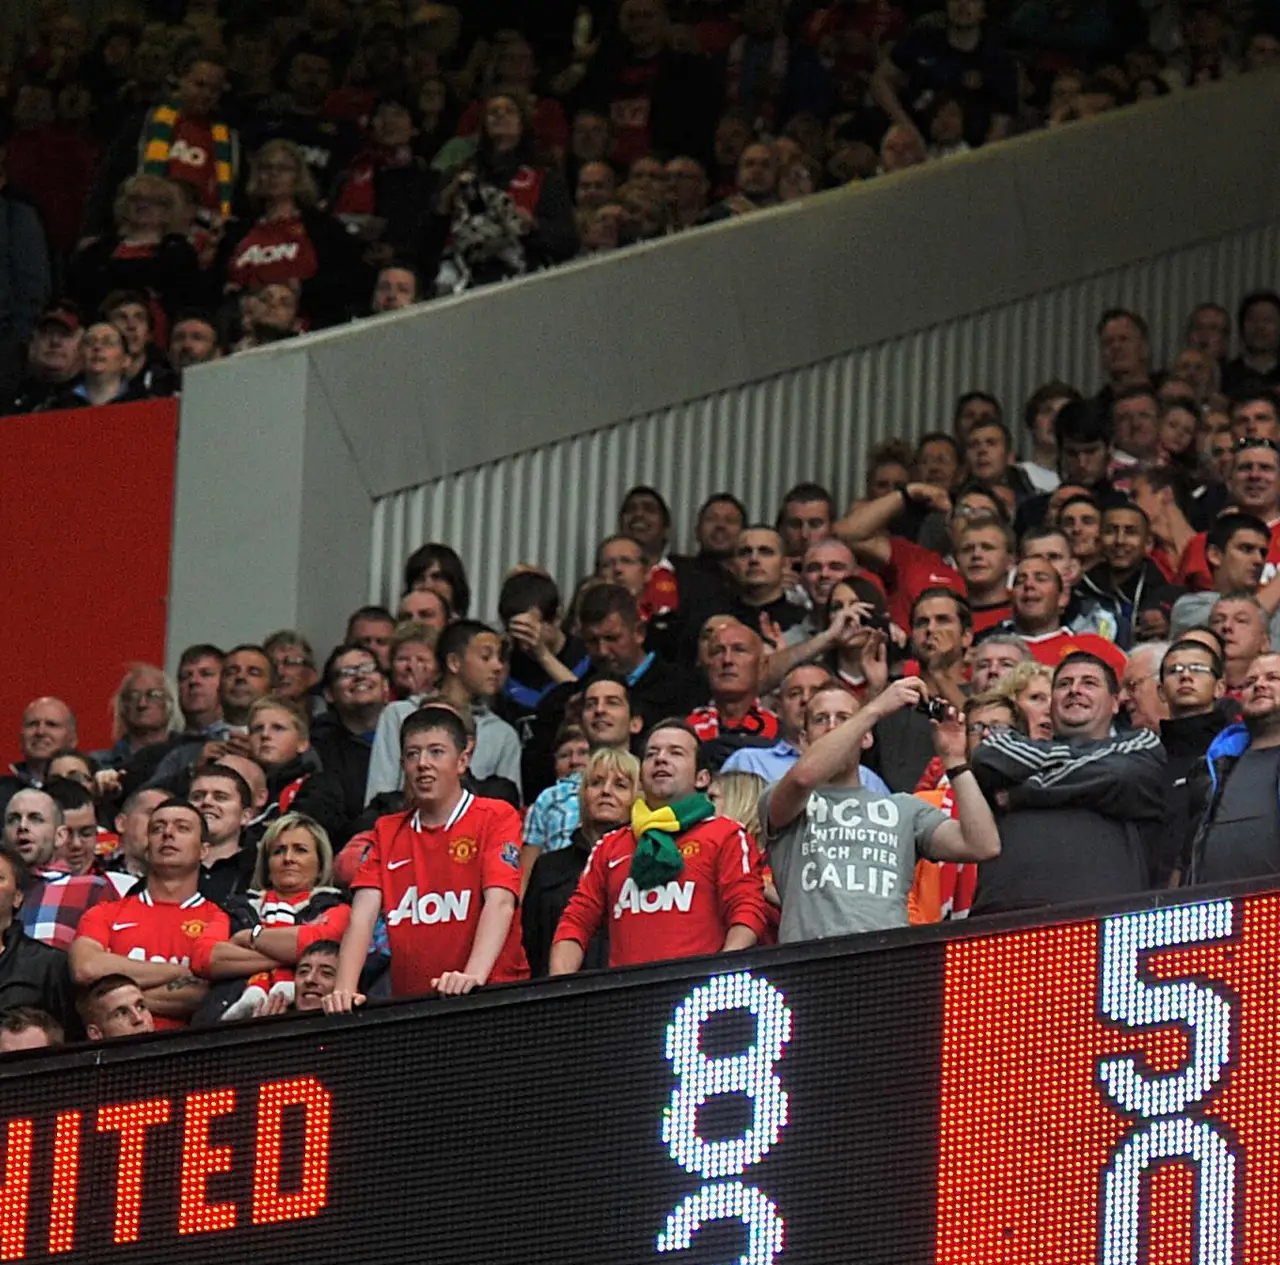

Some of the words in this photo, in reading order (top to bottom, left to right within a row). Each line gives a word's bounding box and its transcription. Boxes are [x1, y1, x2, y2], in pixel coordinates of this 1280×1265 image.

[862, 846, 898, 867] PIER
[614, 877, 695, 919] AON
[801, 861, 898, 898] CALIF
[387, 886, 471, 926] AON
[661, 971, 792, 1178] 8
